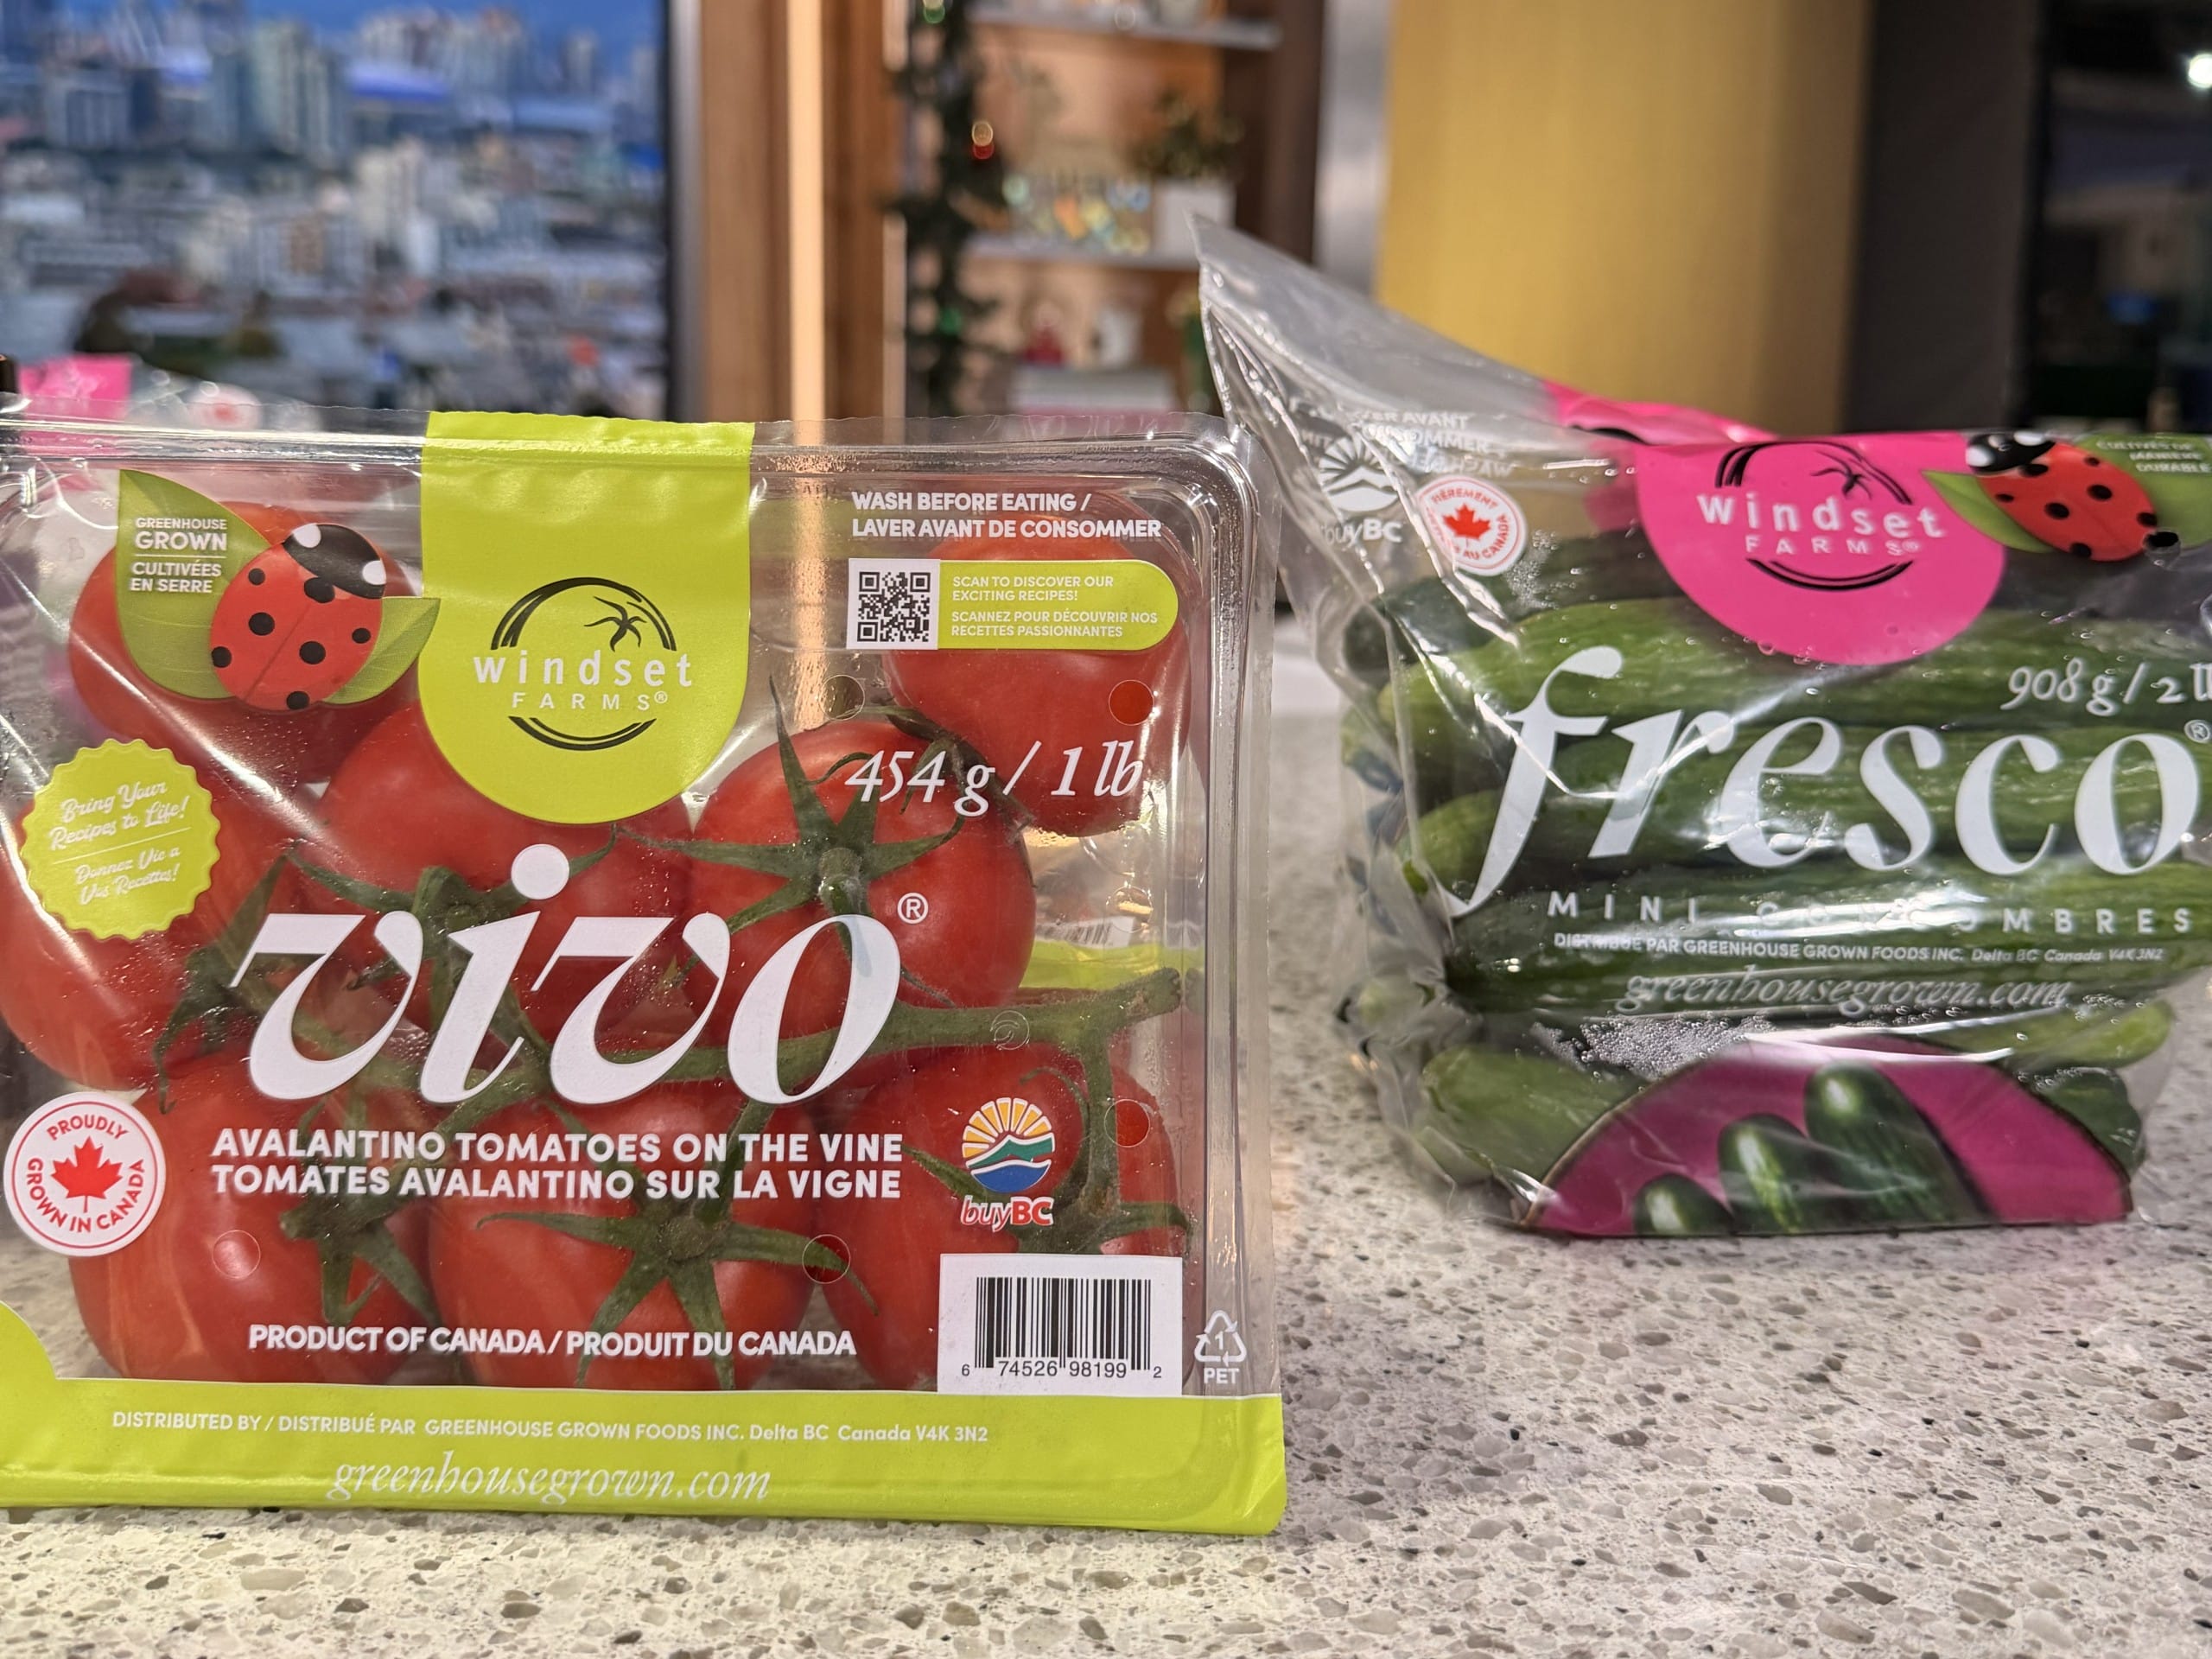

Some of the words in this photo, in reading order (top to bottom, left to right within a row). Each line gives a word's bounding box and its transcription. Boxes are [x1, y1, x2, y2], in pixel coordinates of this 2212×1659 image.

[1402, 410, 1474, 429] AVANT
[852, 492, 912, 512] WASH
[918, 493, 997, 512] BEFORE
[1002, 493, 1076, 512] EATING
[1696, 492, 1947, 538] windset
[136, 518, 227, 530] GREENHOUSE
[852, 518, 916, 537] LAVER
[918, 519, 985, 537] AVANT
[989, 520, 1017, 537] DE
[1020, 520, 1161, 538] CONSOMMER
[136, 531, 228, 550] GROWN
[131, 560, 221, 577] CULTIVÉES
[953, 576, 988, 588] SCAN
[991, 576, 1010, 588] TO
[1014, 576, 1081, 588] DISCOVER
[1084, 576, 1114, 588] OUR
[130, 578, 154, 592] EN
[157, 579, 213, 594] SERRE
[952, 590, 1015, 602] EXCITING
[1019, 590, 1078, 602] RECIPES!
[951, 611, 1011, 624] SCANNEZ
[1014, 612, 1050, 624] POUR
[1053, 607, 1128, 624] DÉCOUVRIR
[1131, 613, 1158, 625] NOS
[951, 626, 1014, 638] RECETTES
[1018, 626, 1123, 639] PASSIONNANTES
[474, 650, 692, 688] windset
[1999, 657, 2084, 710] 908
[2086, 674, 2119, 717] g
[2123, 662, 2147, 705] /
[2156, 677, 2186, 704] 2
[844, 750, 946, 803] 454
[954, 764, 996, 817] g
[1002, 741, 1042, 796] /
[1051, 746, 1084, 797] 1
[1094, 740, 1144, 798] lb
[60, 795, 115, 823] Bring
[117, 781, 168, 810] Your
[49, 820, 117, 851] Recipes
[122, 813, 139, 830] to
[145, 795, 190, 828] Life!
[75, 859, 134, 885] Donnez
[138, 847, 167, 869] Vie
[79, 884, 110, 906] Vos
[114, 863, 181, 895] Recettes!
[1548, 891, 1700, 924] MINI
[1646, 938, 1679, 953] PAR
[1683, 938, 1799, 959] GREENHOUSE
[1803, 944, 1868, 961] GROWN
[1872, 946, 1929, 961] FOODS
[1931, 947, 1964, 962] INC.
[1971, 949, 2014, 962] Delta
[2016, 949, 2038, 962] BC
[2044, 949, 2101, 962] Canada
[1615, 963, 2072, 1019] greenhousegrown.com
[46, 1114, 129, 1141] PROUDLY
[211, 1128, 446, 1160] AVALANTINO
[455, 1132, 661, 1162] TOMATOES
[672, 1133, 728, 1162] ON
[739, 1133, 809, 1162] THE
[819, 1134, 903, 1162] VINE
[27, 1157, 68, 1228] GROWN
[69, 1216, 92, 1233] IN
[96, 1159, 145, 1230] CANADA
[212, 1165, 391, 1196] TOMATES
[398, 1167, 634, 1199] AVALANTINO
[645, 1169, 721, 1199] SUR
[734, 1170, 778, 1199] LA
[787, 1170, 901, 1199] VIGNE
[960, 1195, 1054, 1232] buyBC
[249, 1325, 384, 1351] PRODUCT
[386, 1326, 427, 1352] OF
[430, 1327, 546, 1354] CANADA
[567, 1331, 690, 1357] PRODUIT
[693, 1331, 733, 1357] DU
[738, 1331, 857, 1356] CANADA
[1215, 1331, 1224, 1350] 1
[961, 1363, 970, 1377] 6
[998, 1360, 1058, 1376] 74526
[1069, 1361, 1127, 1379] 98199
[1153, 1366, 1162, 1379] 2
[1204, 1368, 1239, 1384] PET
[112, 1411, 233, 1432] DISTRIBUTED
[238, 1415, 262, 1432] BY
[279, 1413, 375, 1433] DISTRIBUÉ
[380, 1419, 415, 1435] PAR
[425, 1418, 553, 1438] GREENHOUSE
[557, 1421, 630, 1440] GROWN
[635, 1423, 702, 1440] FOODS
[707, 1424, 744, 1440] INC.
[749, 1424, 798, 1441] Delta
[804, 1424, 829, 1441] BC
[837, 1424, 911, 1442] Canada
[916, 1426, 950, 1442] V4K
[954, 1426, 988, 1443] 3N2
[325, 1450, 772, 1506] greenhousegrown.com
